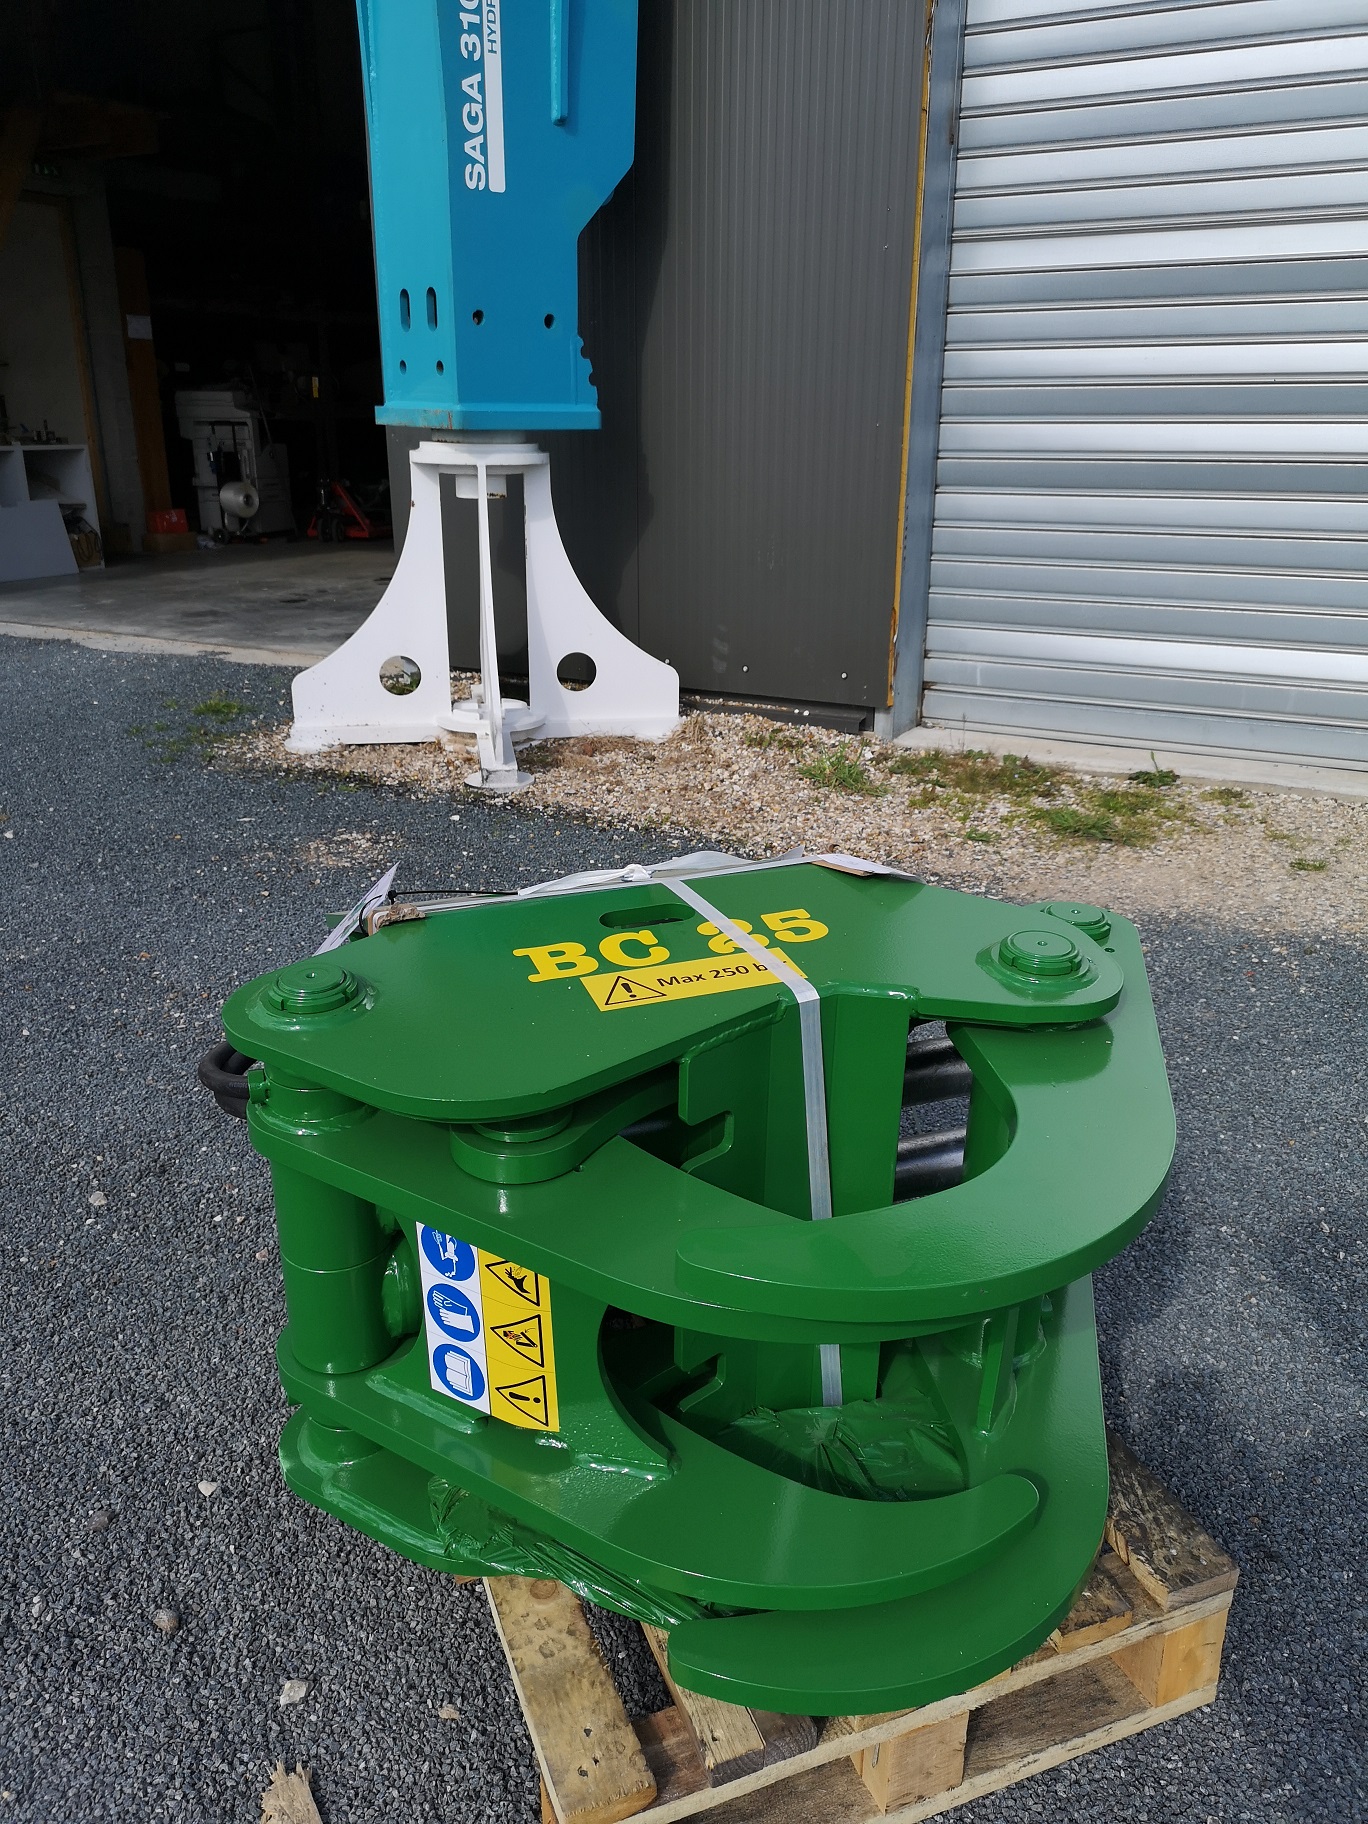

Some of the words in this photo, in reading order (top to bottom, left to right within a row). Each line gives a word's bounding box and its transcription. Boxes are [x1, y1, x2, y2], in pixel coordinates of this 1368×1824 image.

[460, 72, 487, 191] SAGA
[512, 929, 671, 983] BC
[696, 908, 829, 955] 25
[656, 973, 707, 988] Max
[708, 965, 750, 979] 250
